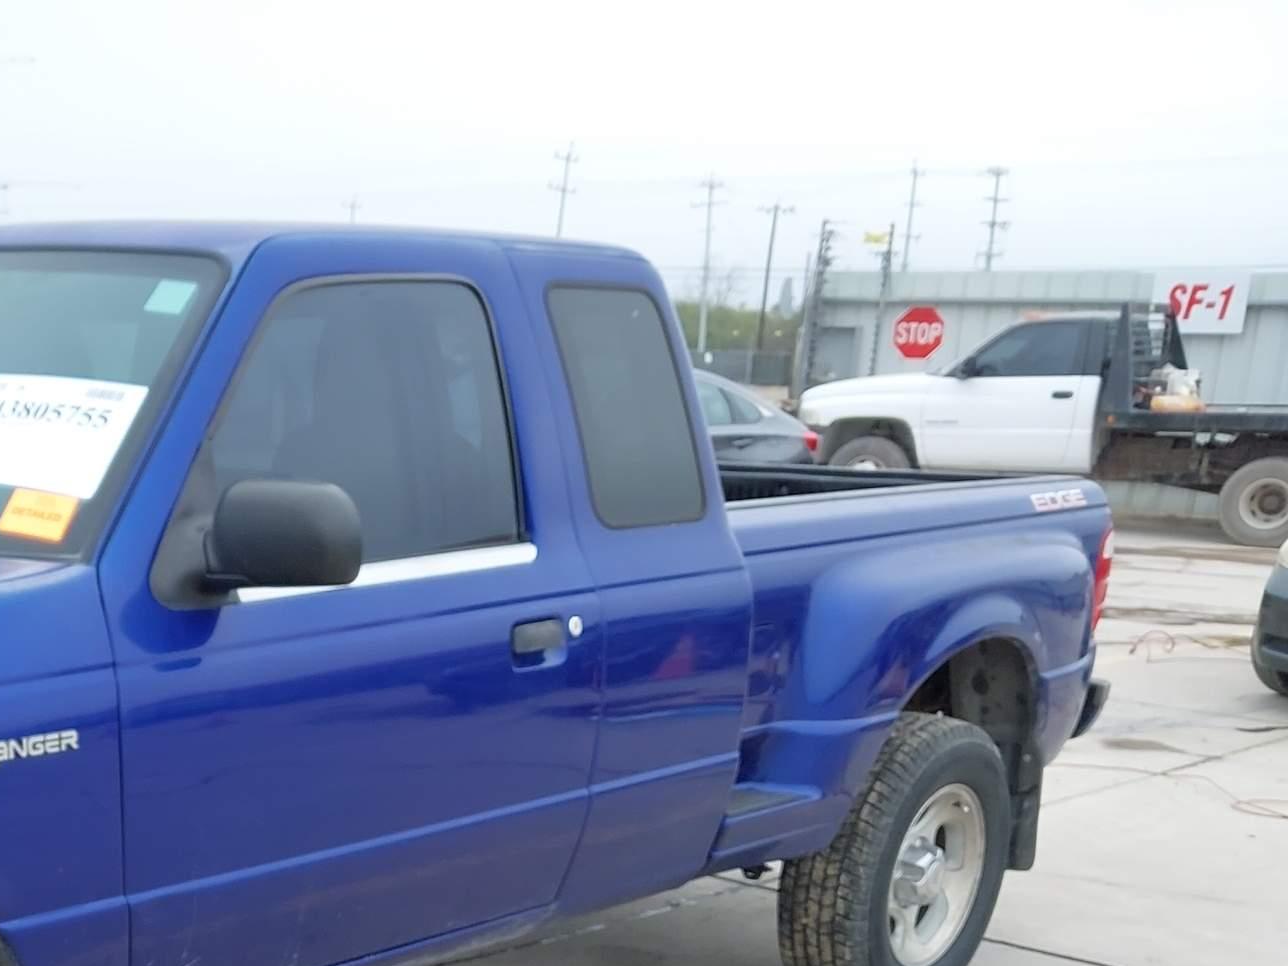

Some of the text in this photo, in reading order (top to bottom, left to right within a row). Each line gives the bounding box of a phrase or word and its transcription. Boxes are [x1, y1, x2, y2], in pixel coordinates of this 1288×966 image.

[1169, 283, 1236, 320] SF-1
[896, 321, 943, 345] STOP
[1030, 488, 1088, 512] EDGE
